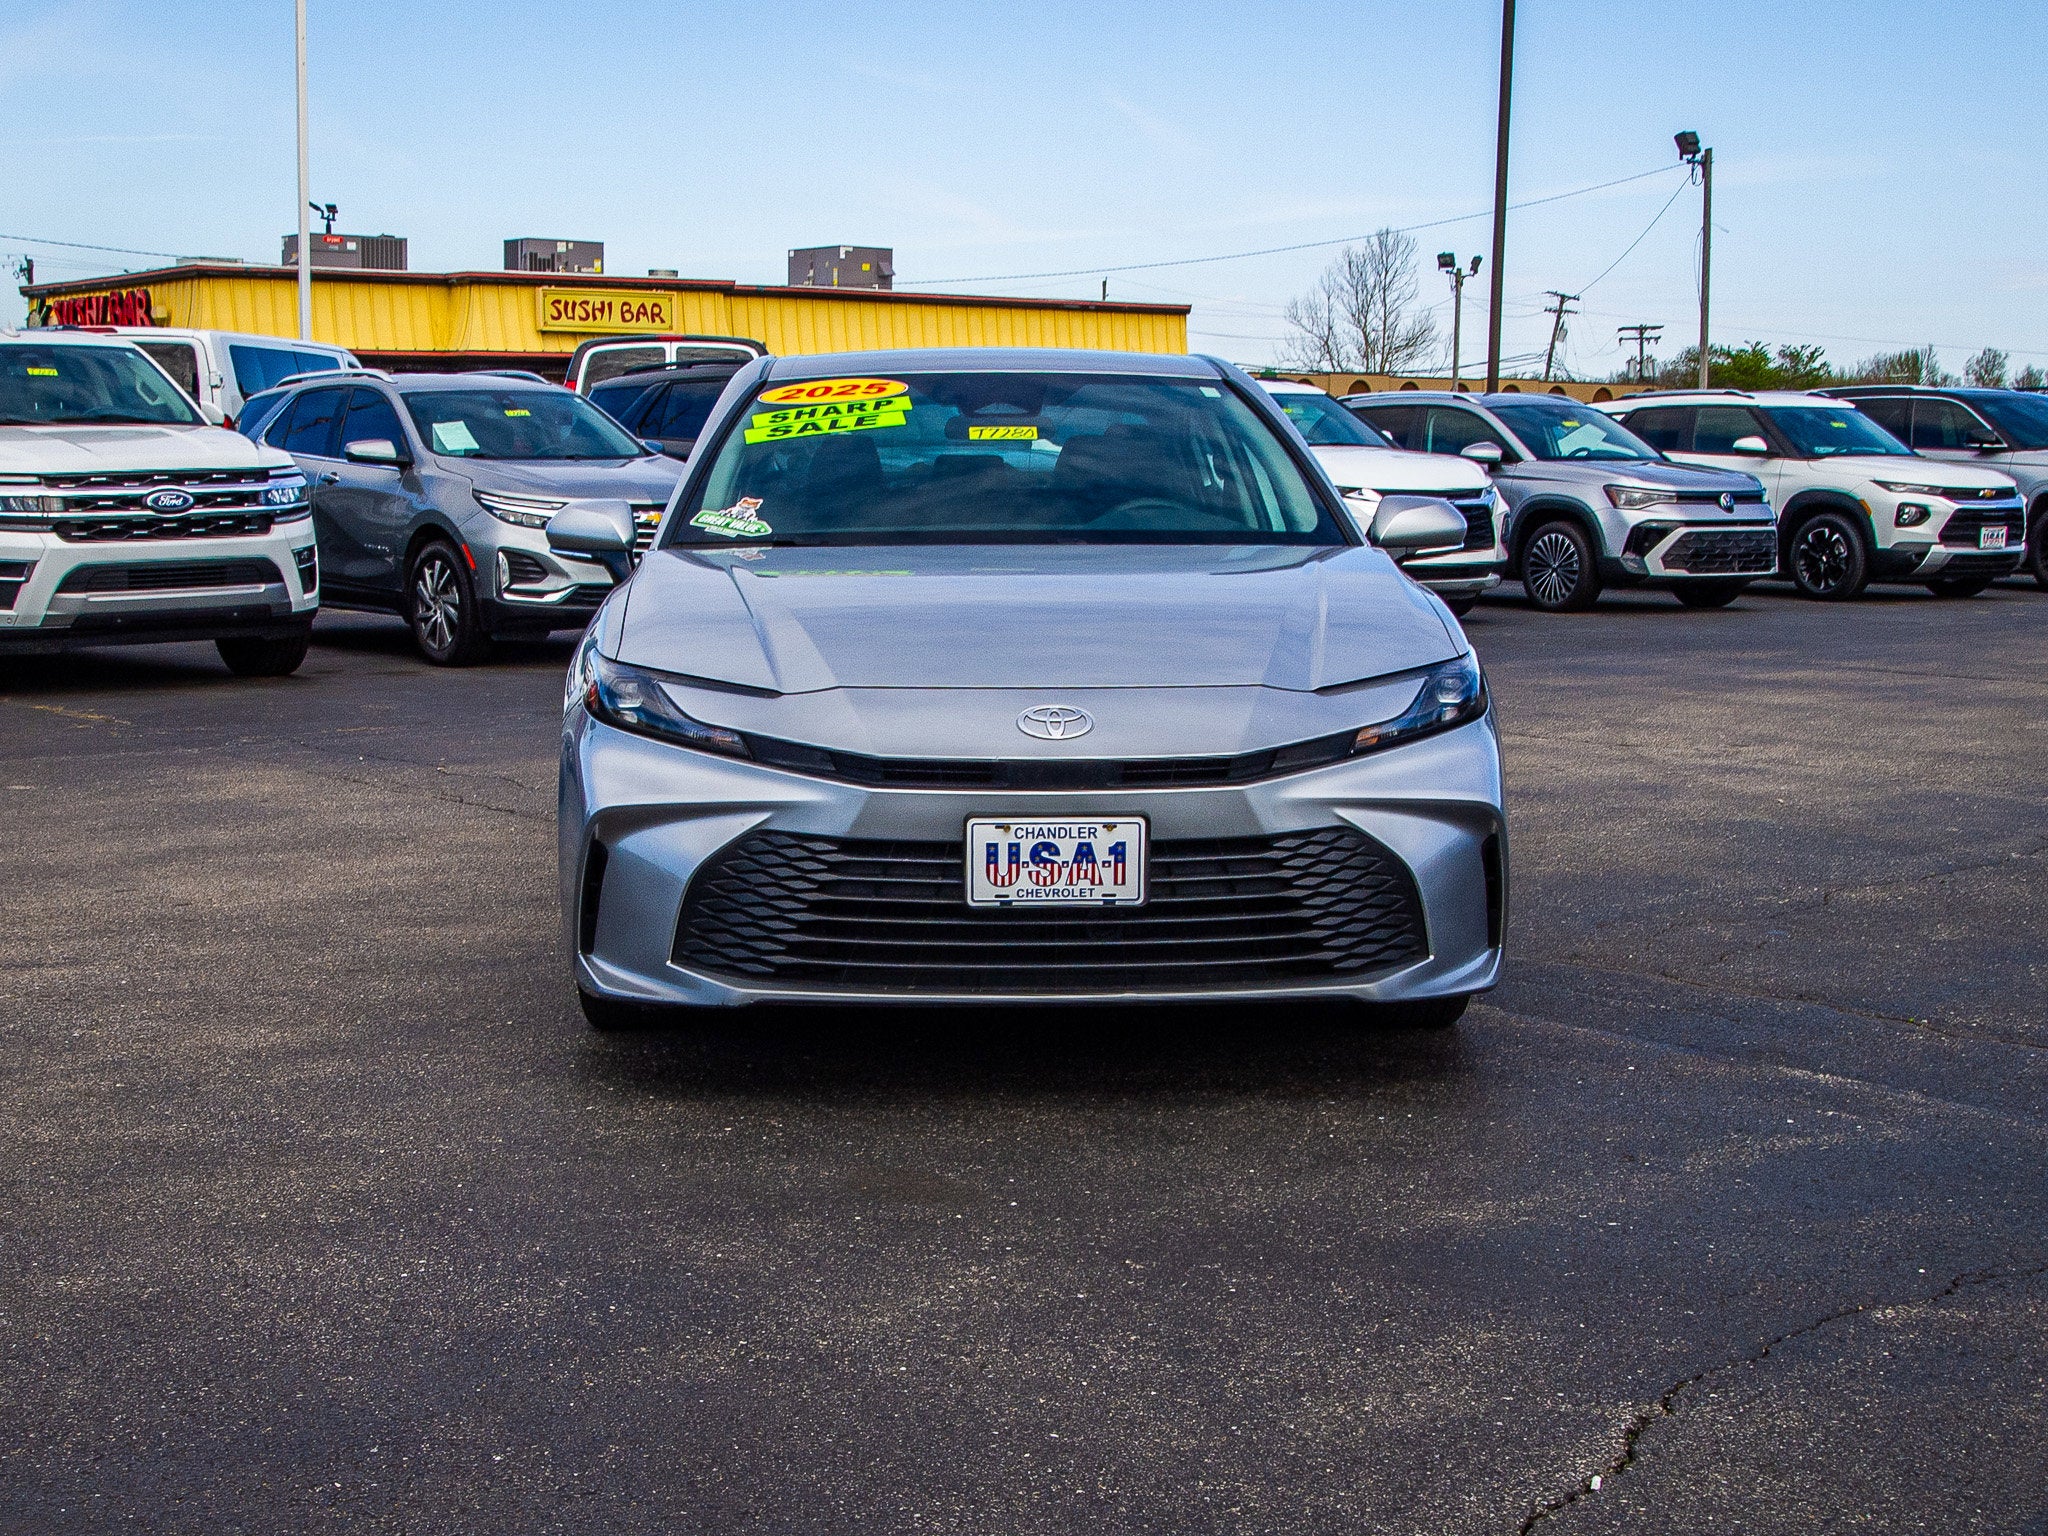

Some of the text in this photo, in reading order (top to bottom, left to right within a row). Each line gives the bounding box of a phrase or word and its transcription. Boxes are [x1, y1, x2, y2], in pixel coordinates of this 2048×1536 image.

[53, 287, 151, 327] SUSHI BAR
[550, 299, 666, 324] SUSHI BAR
[776, 382, 891, 401] 2025
[769, 399, 894, 424] SHARP
[766, 414, 880, 438] SALE
[158, 494, 184, 507] Ford
[698, 513, 733, 527] GREAT
[728, 517, 761, 533] VALUE
[1014, 826, 1098, 840] CHANDLER
[1016, 888, 1096, 899] CHEVROLET
